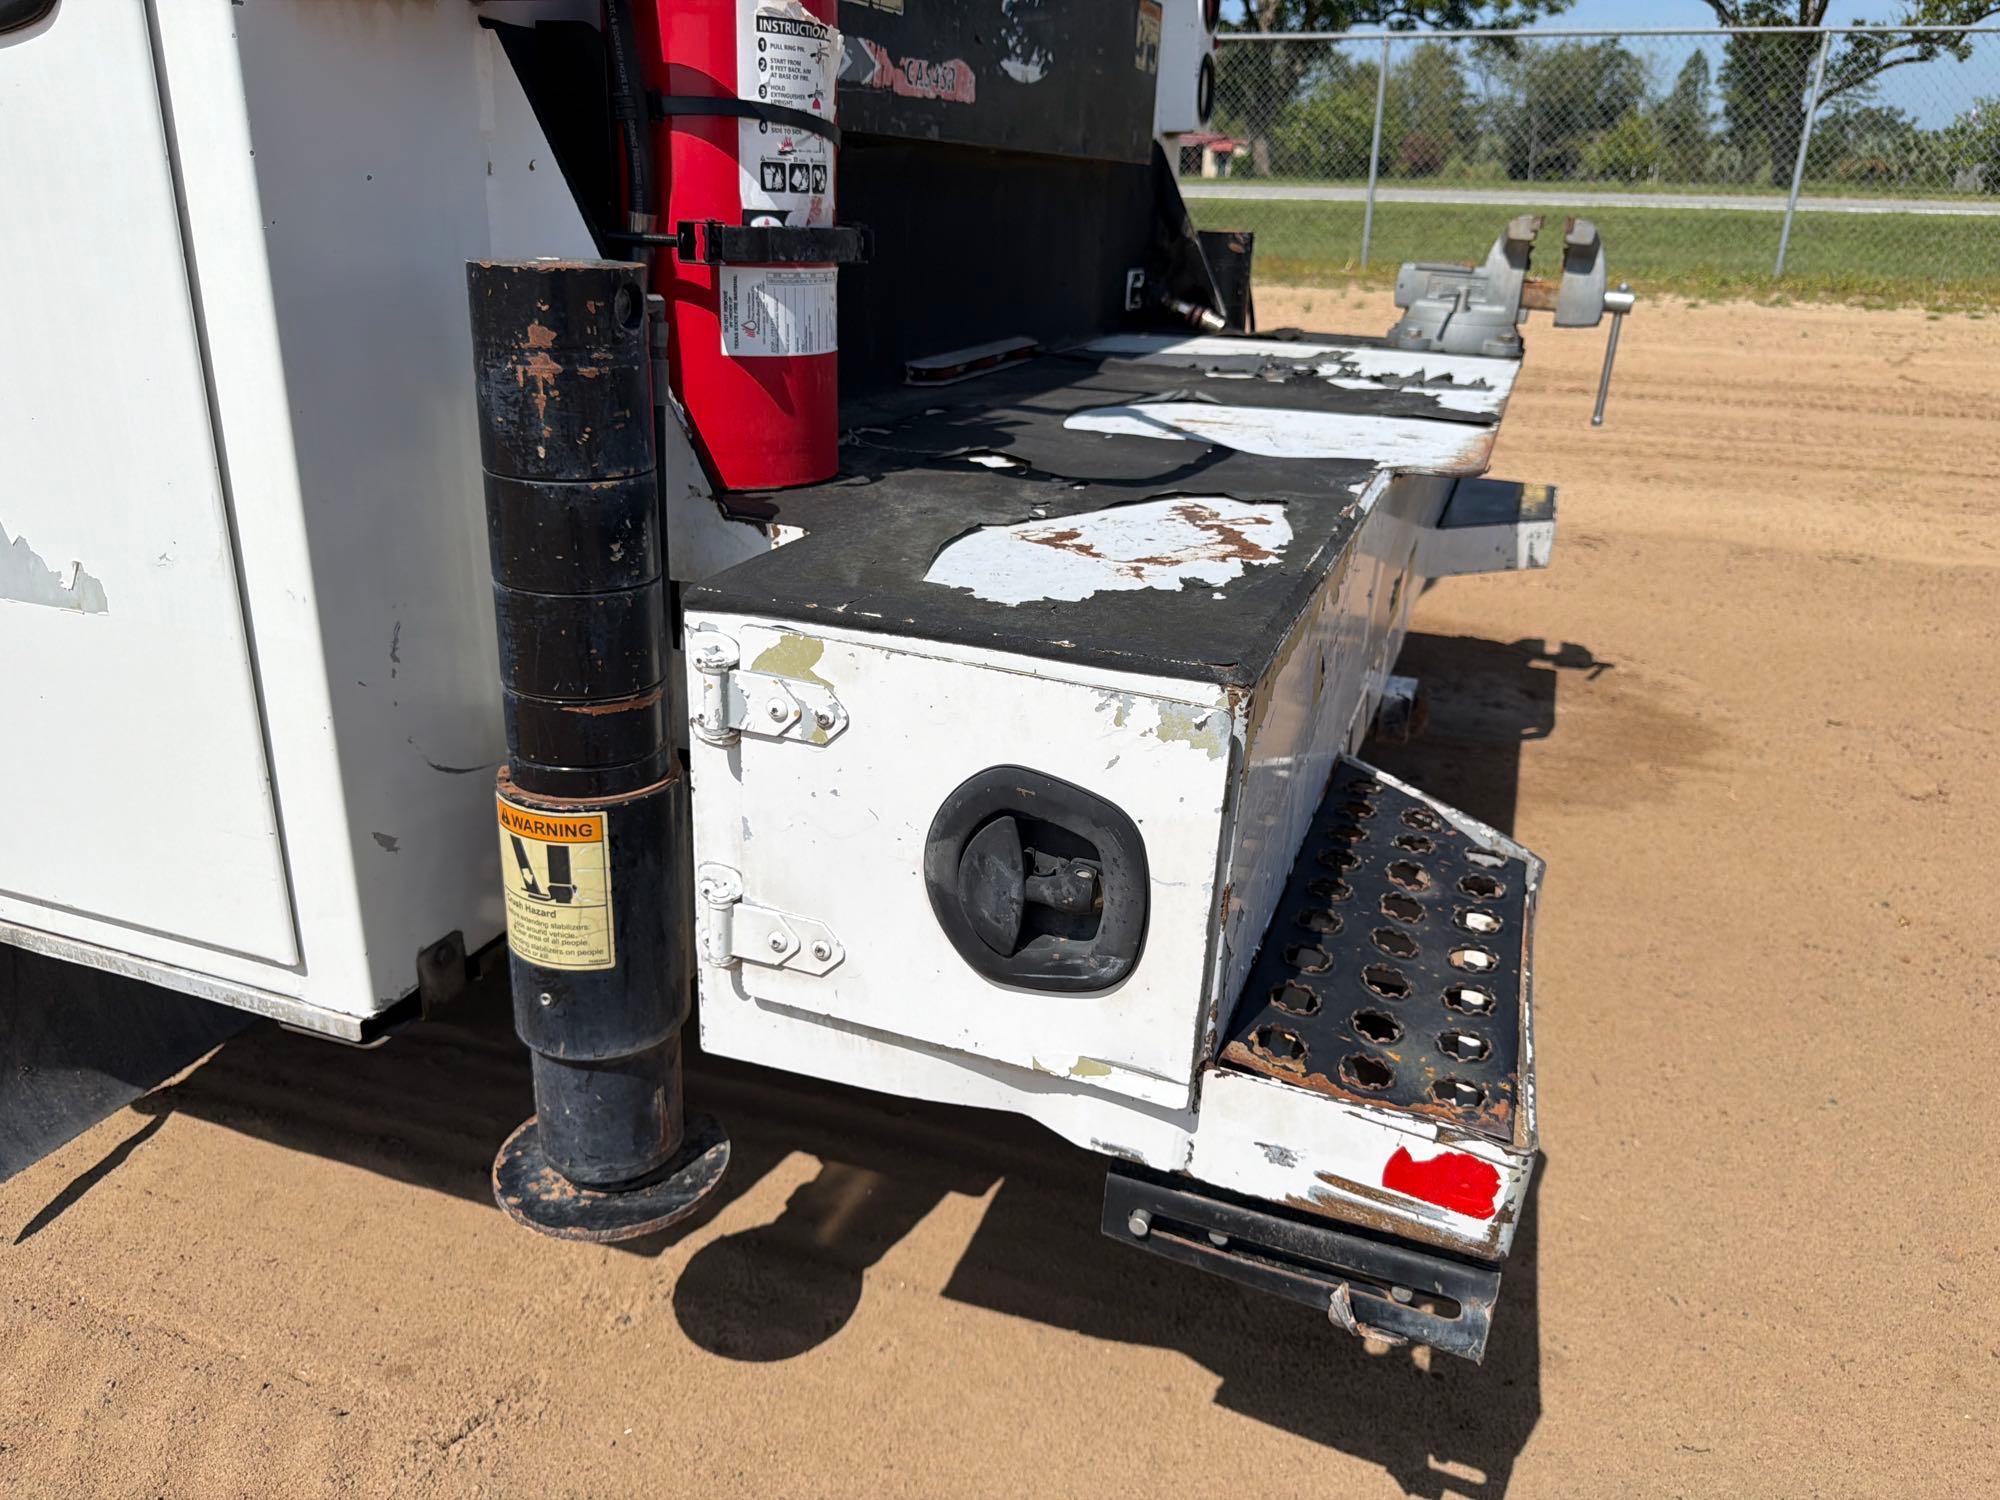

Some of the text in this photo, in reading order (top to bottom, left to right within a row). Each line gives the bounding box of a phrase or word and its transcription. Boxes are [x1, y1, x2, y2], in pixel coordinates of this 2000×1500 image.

[784, 44, 796, 52] RING
[770, 92, 806, 100] EXTINGUISHER
[511, 814, 593, 837] WARNING
[525, 905, 557, 919] Hazard
[526, 925, 547, 936] around
[528, 932, 541, 941] area
[531, 942, 563, 955] stabilizers
